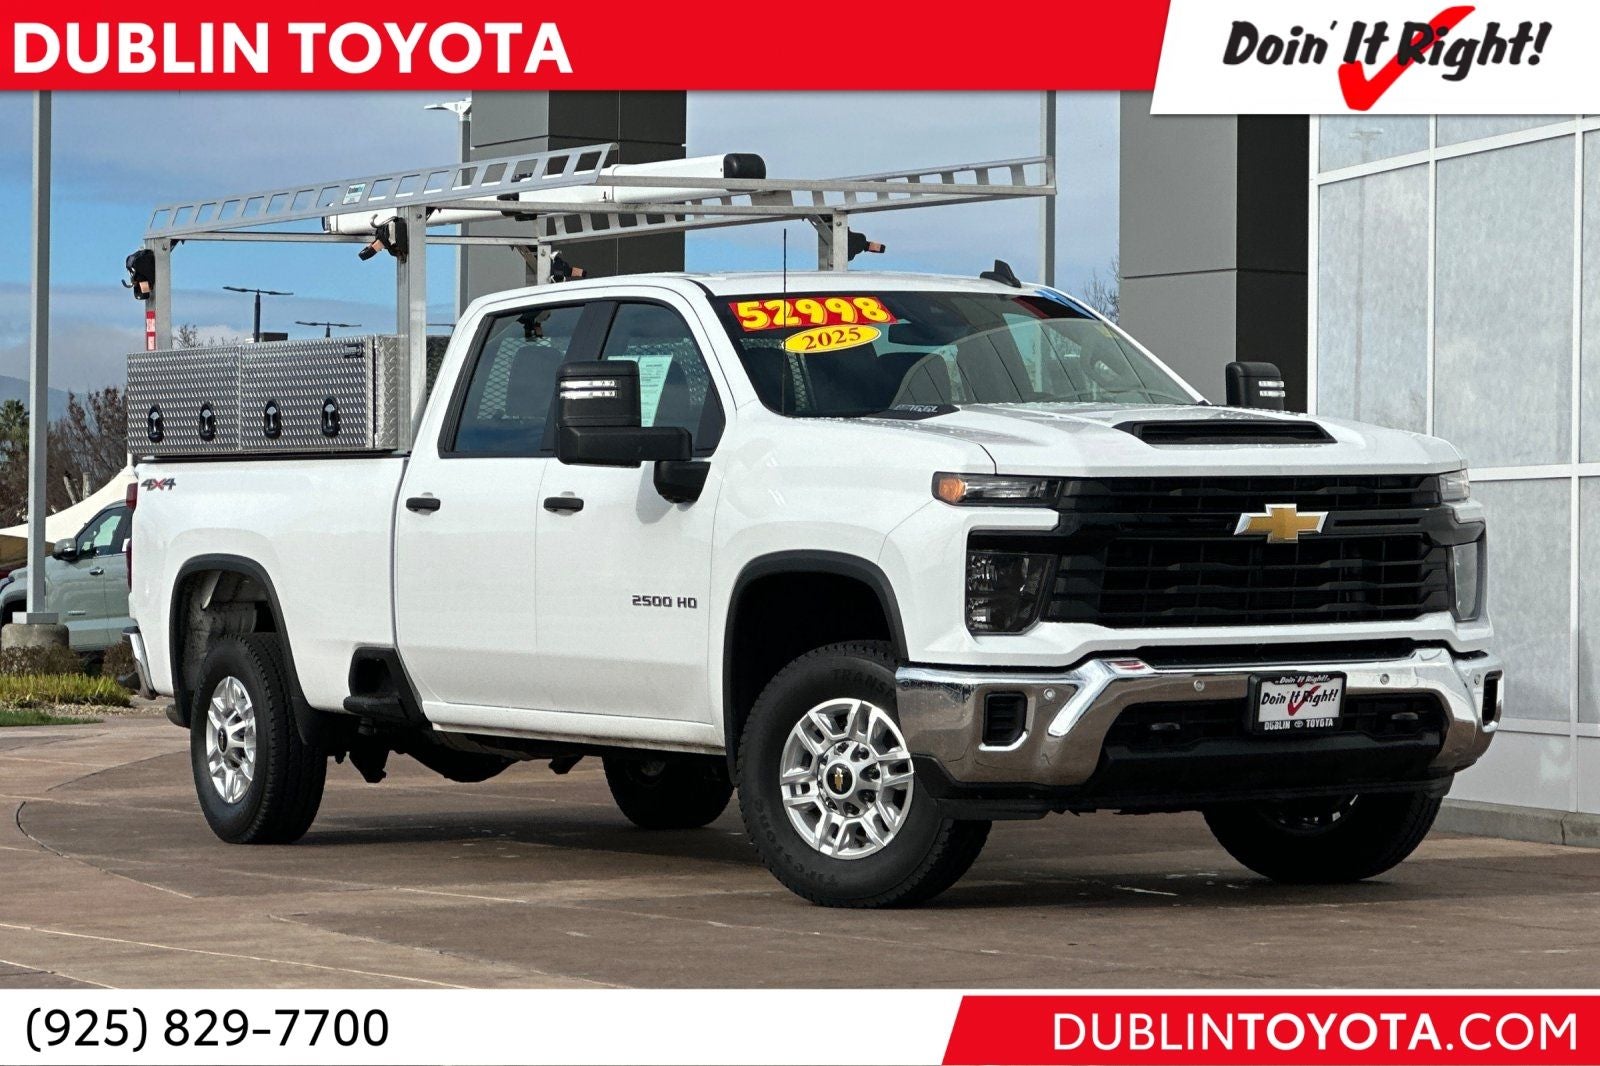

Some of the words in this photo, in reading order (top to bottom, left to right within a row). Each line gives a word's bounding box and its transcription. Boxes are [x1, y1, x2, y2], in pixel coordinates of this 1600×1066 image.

[737, 297, 890, 329] 52998
[801, 327, 862, 351] 2025
[631, 595, 673, 608] 2500
[677, 597, 698, 609] HD
[1303, 689, 1339, 707] Right!
[1264, 721, 1291, 731] DUBLIN
[1306, 718, 1334, 728] TOYOTA
